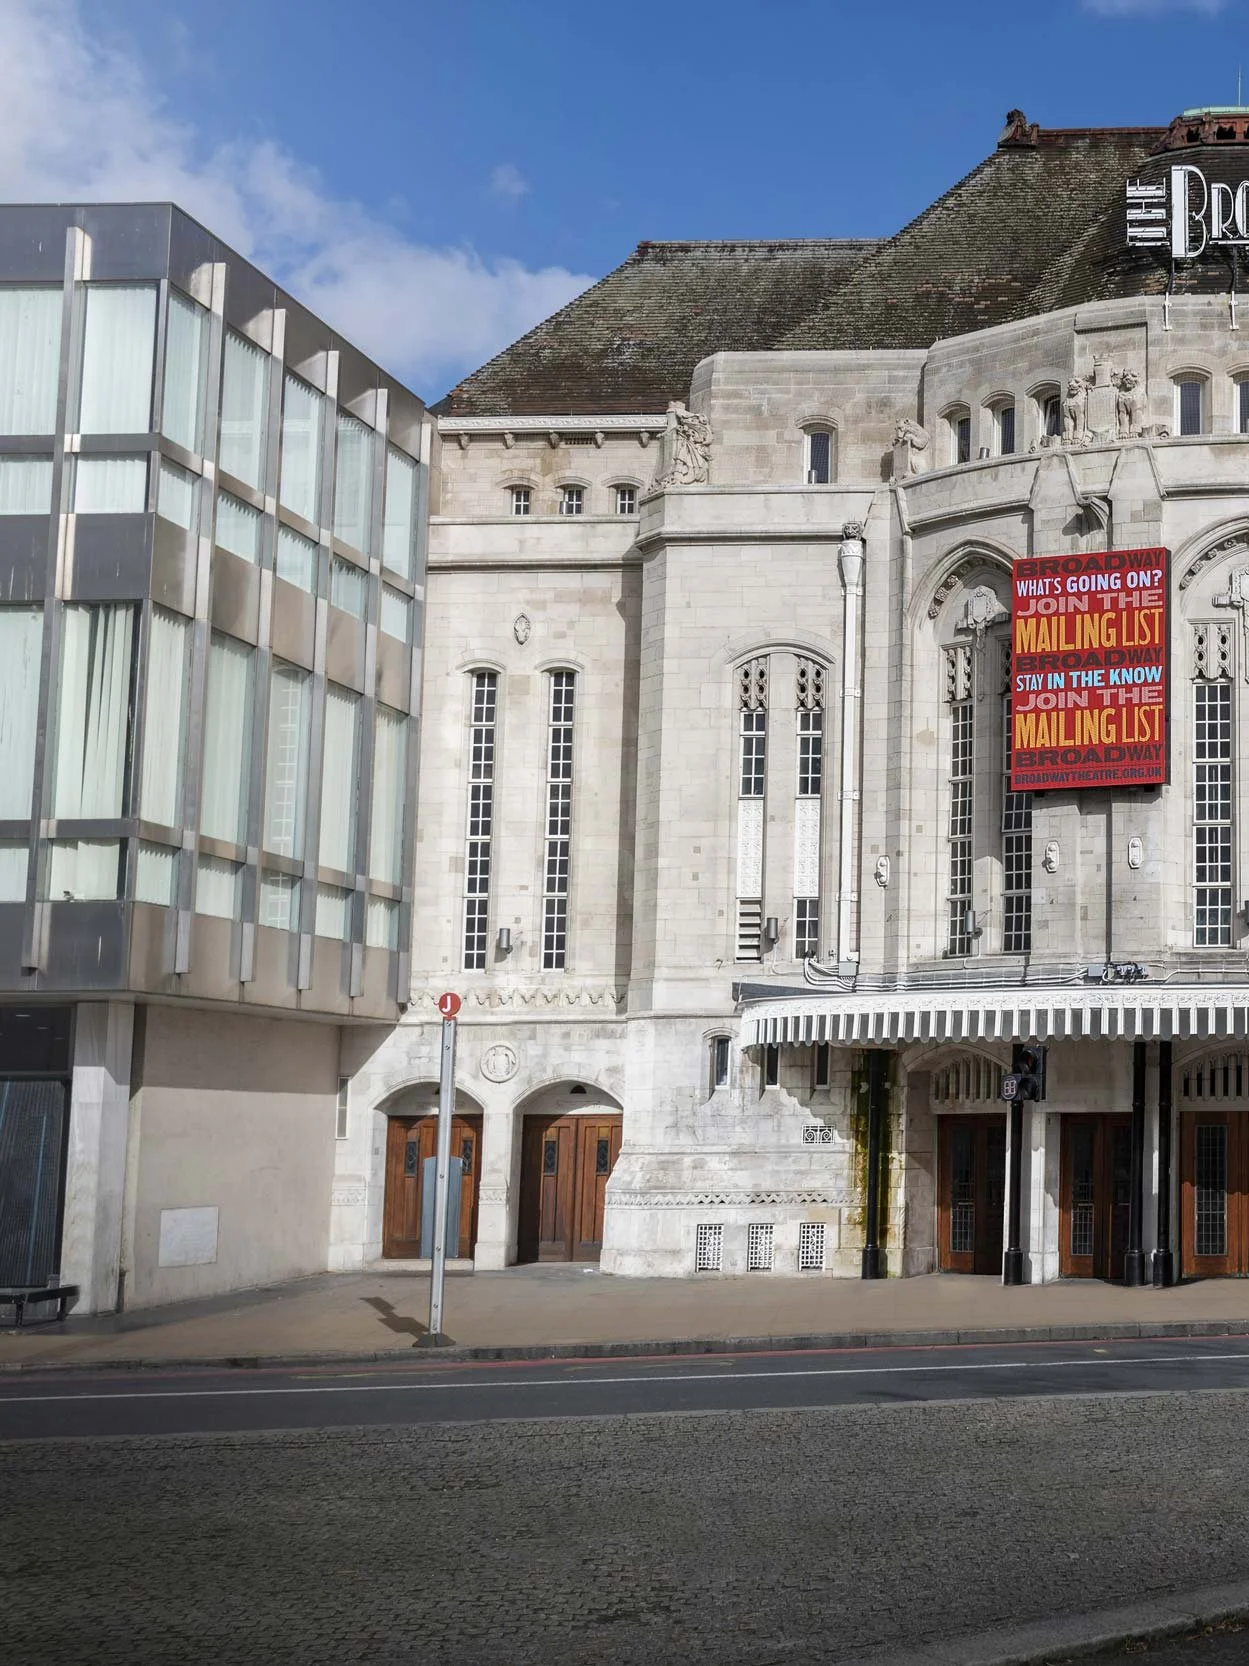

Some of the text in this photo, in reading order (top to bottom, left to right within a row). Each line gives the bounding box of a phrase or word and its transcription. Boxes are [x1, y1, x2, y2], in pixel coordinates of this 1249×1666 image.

[1126, 177, 1170, 247] THE
[1017, 550, 1162, 577] BROADWAY
[1016, 569, 1162, 597] WHAT'S GOING ON?
[1016, 589, 1163, 616] JOIN THE
[1015, 608, 1163, 653] MAILING LIST
[1016, 647, 1162, 672] BROADWAY
[1016, 665, 1163, 692] STAY IN THE KNOW
[1015, 686, 1163, 711] JOIN THE
[1015, 704, 1163, 749] MAILING LIST
[1015, 744, 1163, 768] BROADWAY
[1014, 767, 1162, 785] BROADWAYTHEATRE.ORG.UK
[441, 995, 452, 1013] J
